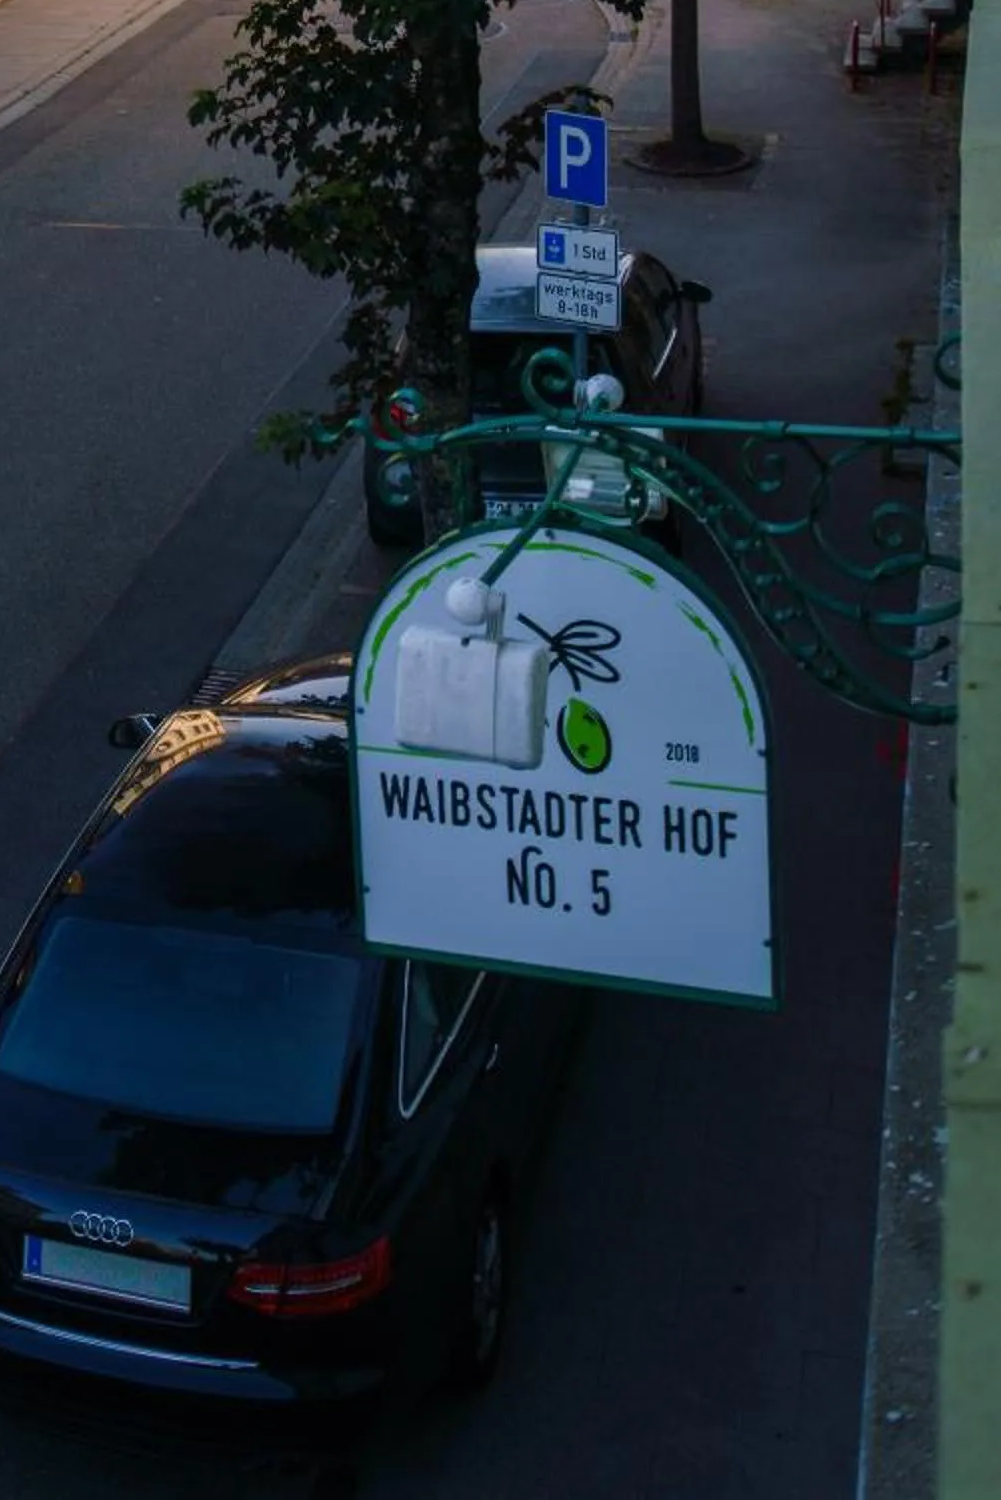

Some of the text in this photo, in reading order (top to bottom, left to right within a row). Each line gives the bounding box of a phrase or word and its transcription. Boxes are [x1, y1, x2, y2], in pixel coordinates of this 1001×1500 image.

[559, 124, 593, 189] P
[573, 243, 606, 261] 1 Std
[544, 283, 614, 305] werktags
[665, 741, 699, 764] 2018
[380, 771, 739, 859] WAIBSTADTER HOF
[506, 845, 612, 917] NO. 5
